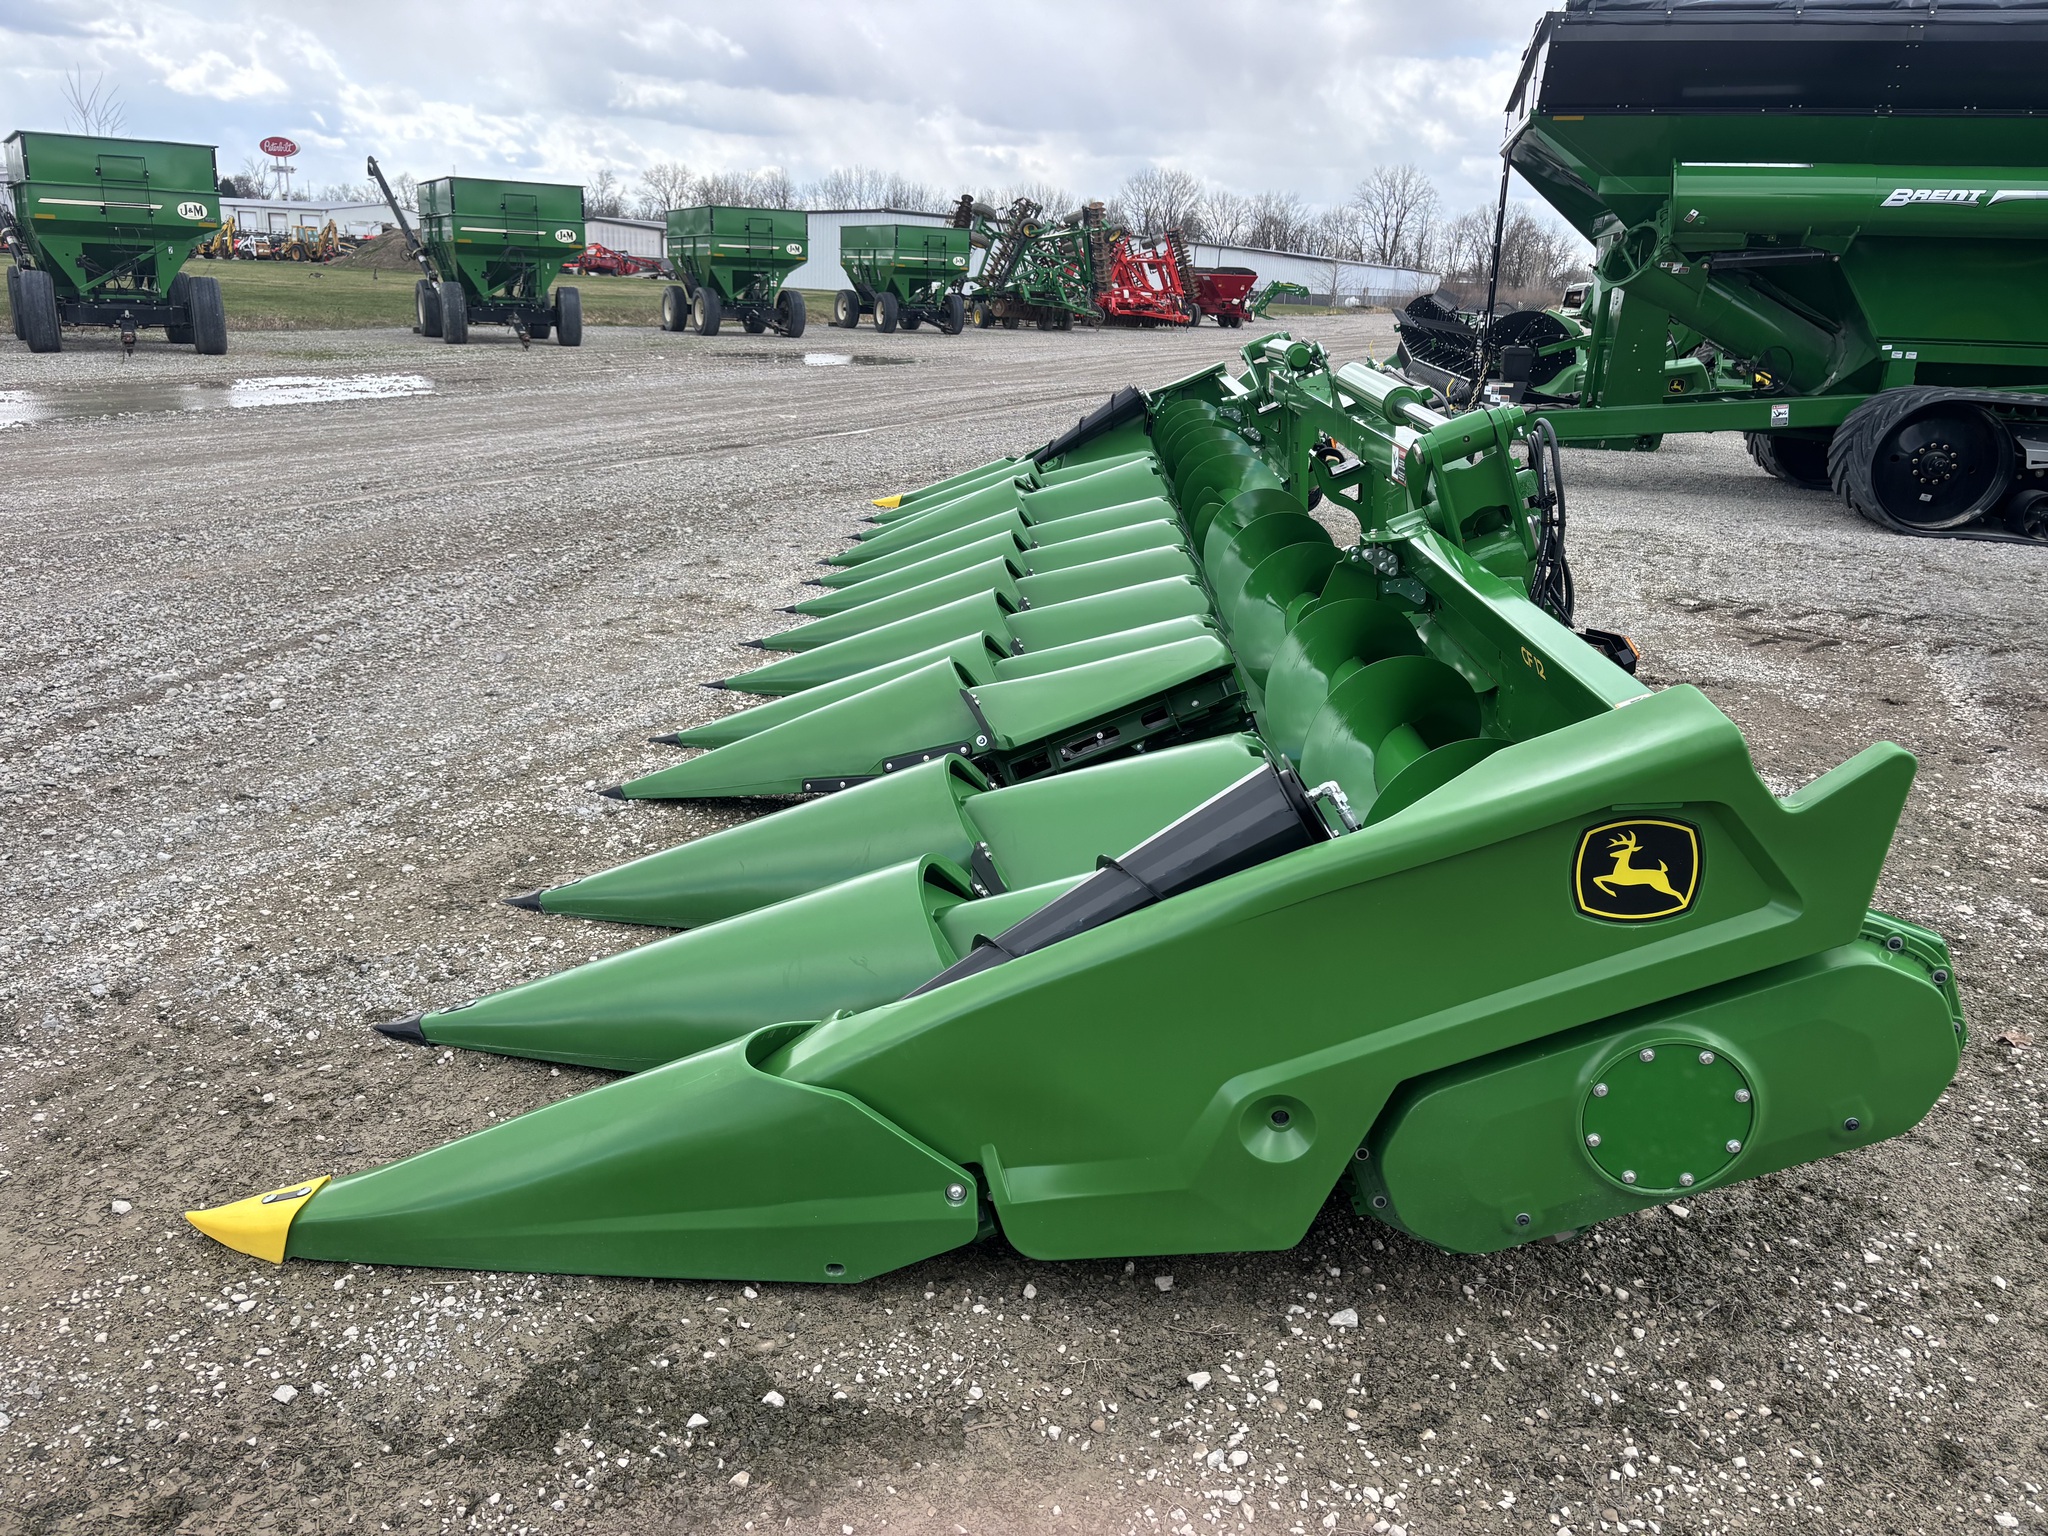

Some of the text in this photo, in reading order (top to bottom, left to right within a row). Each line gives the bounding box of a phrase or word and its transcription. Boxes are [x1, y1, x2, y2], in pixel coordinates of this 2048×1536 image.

[1880, 188, 1987, 207] BRENT
[180, 204, 204, 217] J&M
[557, 230, 574, 241] J&M
